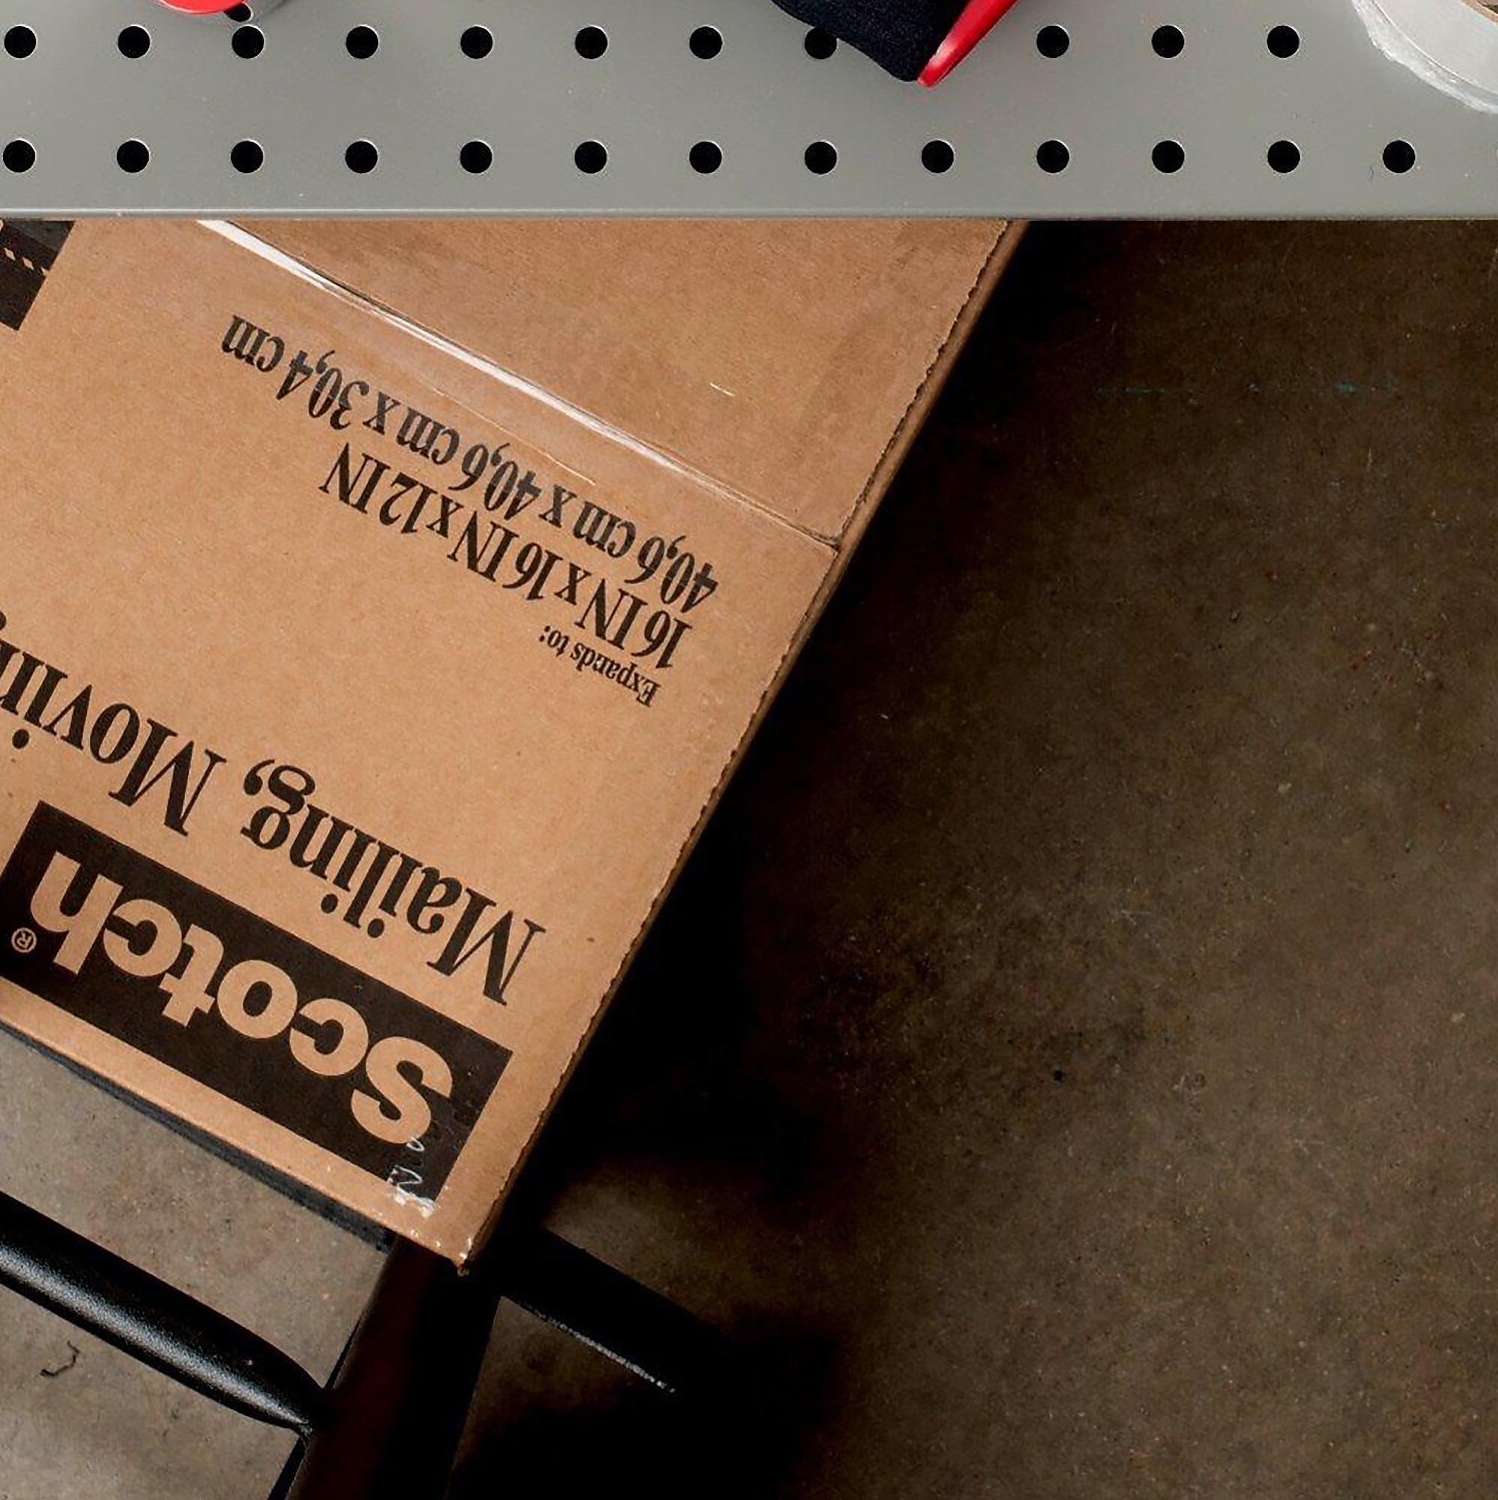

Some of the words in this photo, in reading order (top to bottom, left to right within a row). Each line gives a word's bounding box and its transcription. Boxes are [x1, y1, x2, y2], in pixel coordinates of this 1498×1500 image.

[222, 316, 284, 372] cm
[277, 350, 368, 429] 30,4
[363, 392, 400, 434] x
[397, 408, 459, 464] cm
[449, 443, 541, 520] 40,6
[539, 487, 576, 528] x
[574, 502, 635, 558] cm
[625, 536, 718, 613] 40,6
[538, 624, 570, 657] to:
[570, 642, 660, 706] Expands
[241, 759, 545, 1005] Mailing,
